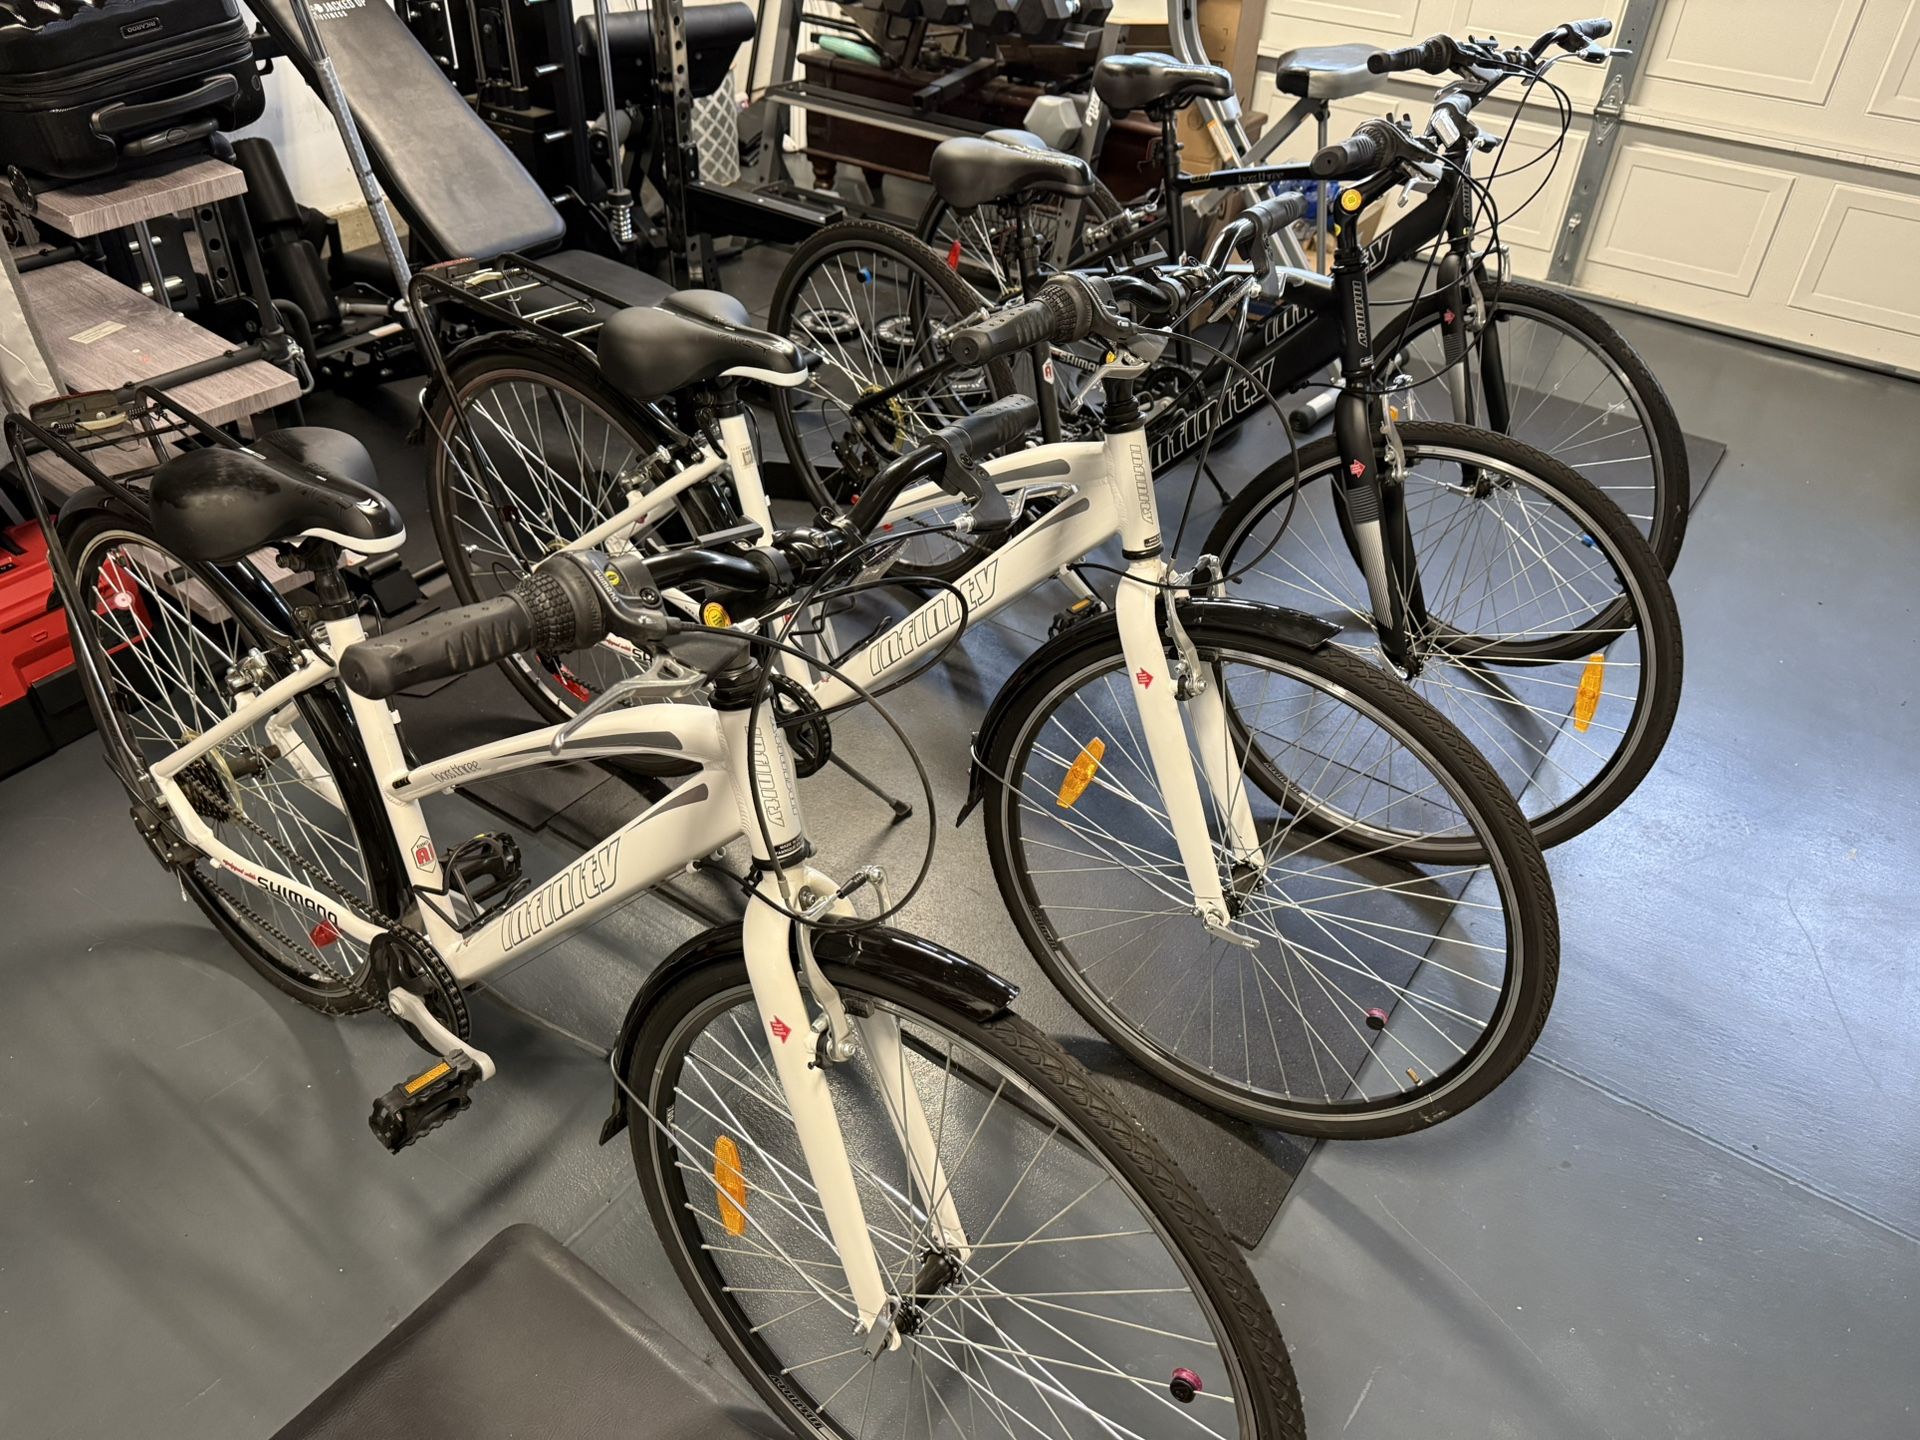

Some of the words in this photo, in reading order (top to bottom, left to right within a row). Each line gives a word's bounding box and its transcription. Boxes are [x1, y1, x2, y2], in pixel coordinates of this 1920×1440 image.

[127, 21, 156, 33] RICARDO
[322, 0, 355, 13] JACKED
[870, 558, 998, 676] infinity
[257, 876, 338, 928] SHIMANO
[501, 836, 621, 952] infinity
